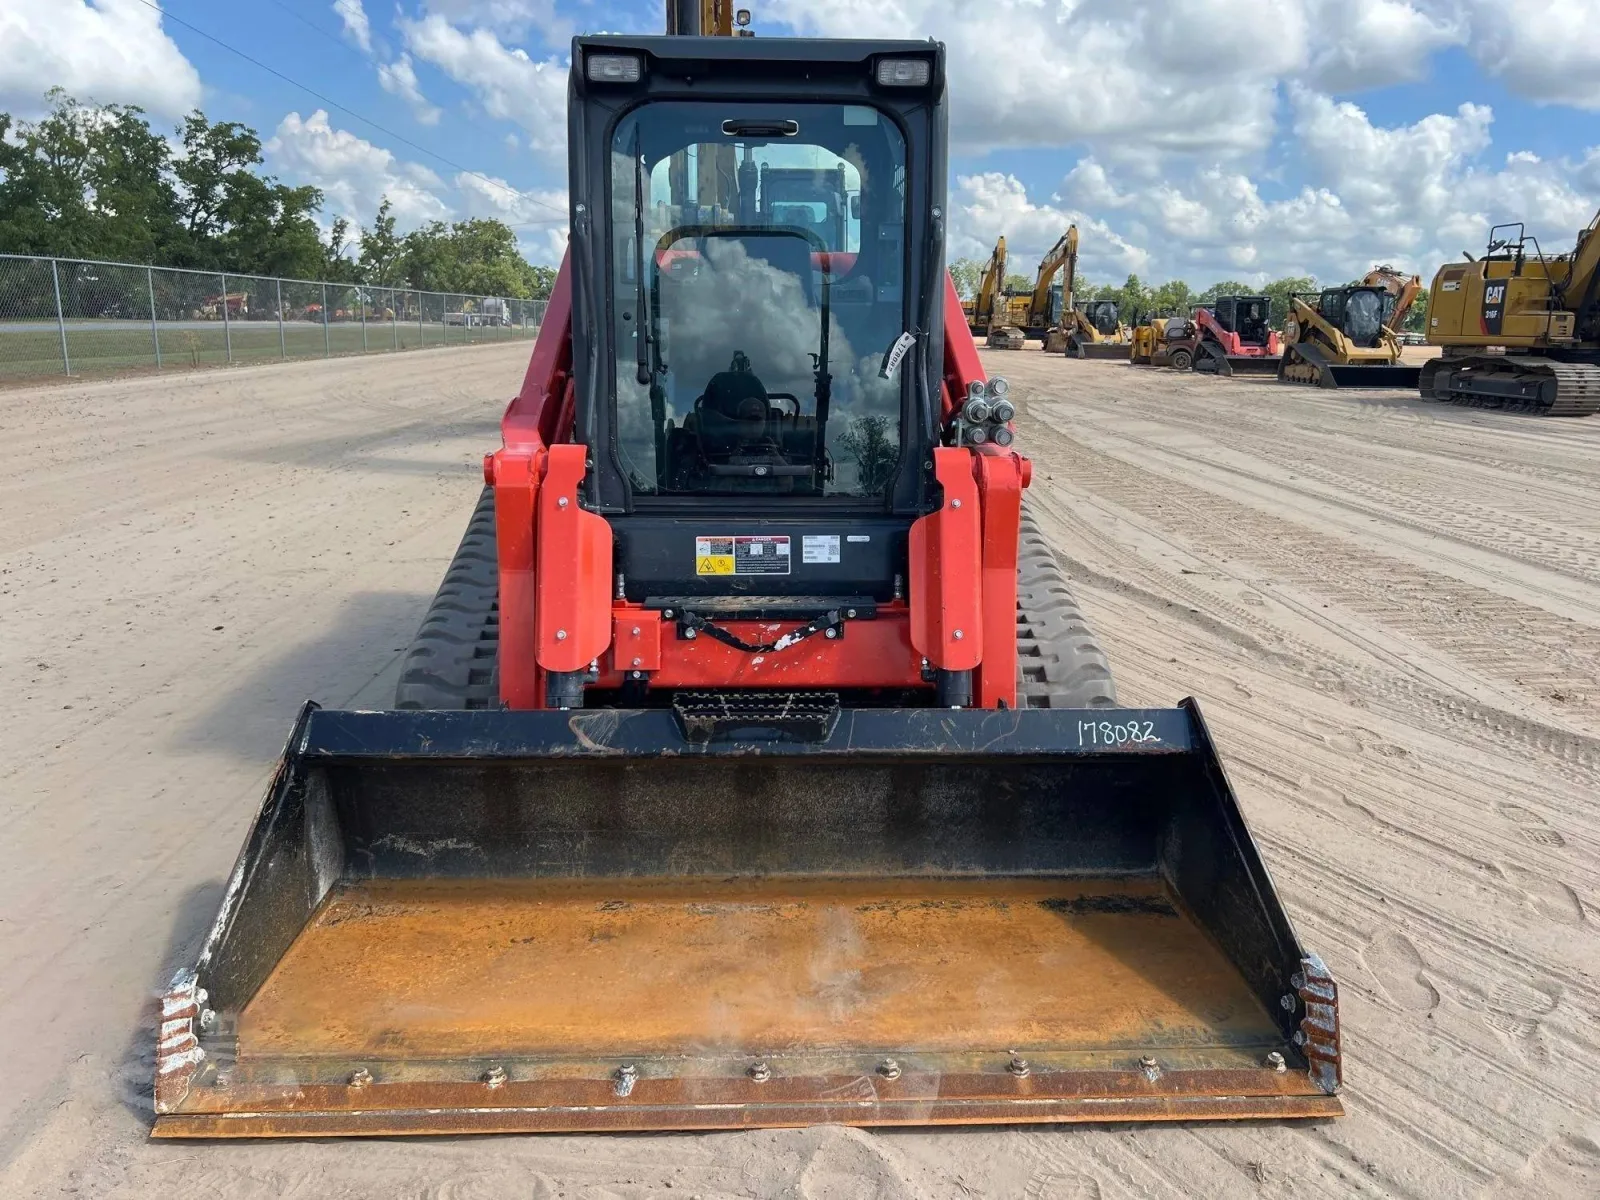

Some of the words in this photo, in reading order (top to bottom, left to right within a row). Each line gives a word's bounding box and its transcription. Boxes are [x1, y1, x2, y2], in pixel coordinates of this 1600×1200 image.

[1485, 286, 1505, 304] CAT
[888, 343, 907, 372] 178082
[1078, 720, 1162, 746] 178082
